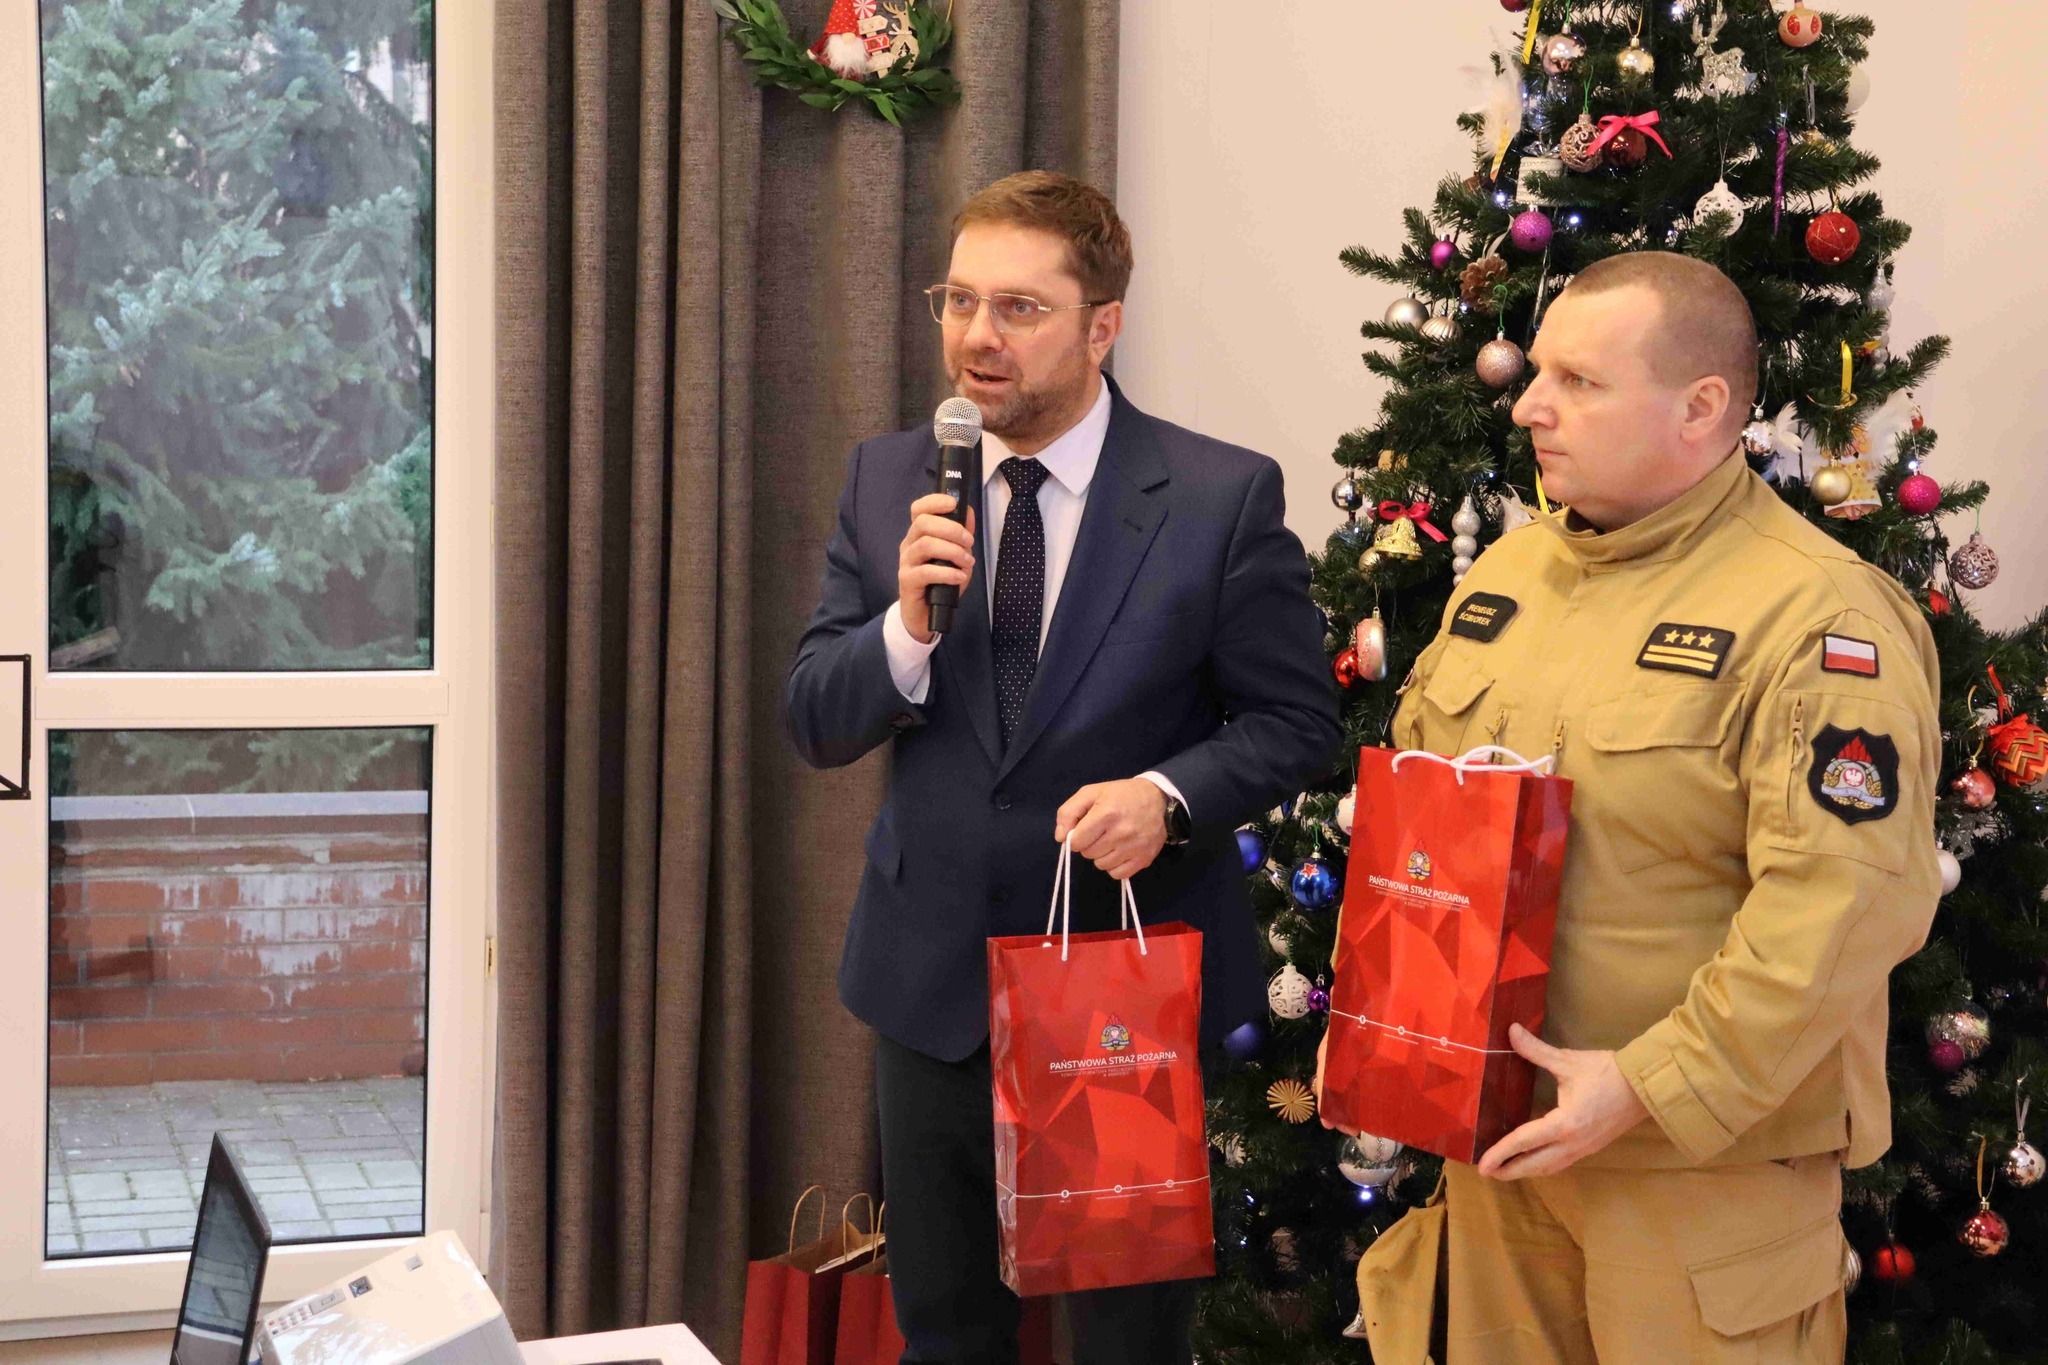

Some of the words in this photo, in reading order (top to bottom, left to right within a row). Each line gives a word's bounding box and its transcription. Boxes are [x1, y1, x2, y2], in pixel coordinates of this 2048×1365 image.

[945, 470, 962, 478] DNA
[1369, 875, 1409, 891] PAŃSTWOWA
[1410, 885, 1432, 898] STRAŻ
[1433, 890, 1470, 905] POŻARNA
[1049, 1059, 1108, 1070] PAŃSTWOWA
[1109, 1054, 1136, 1065] STRAŻ
[1137, 1050, 1177, 1062] POŻARNA
